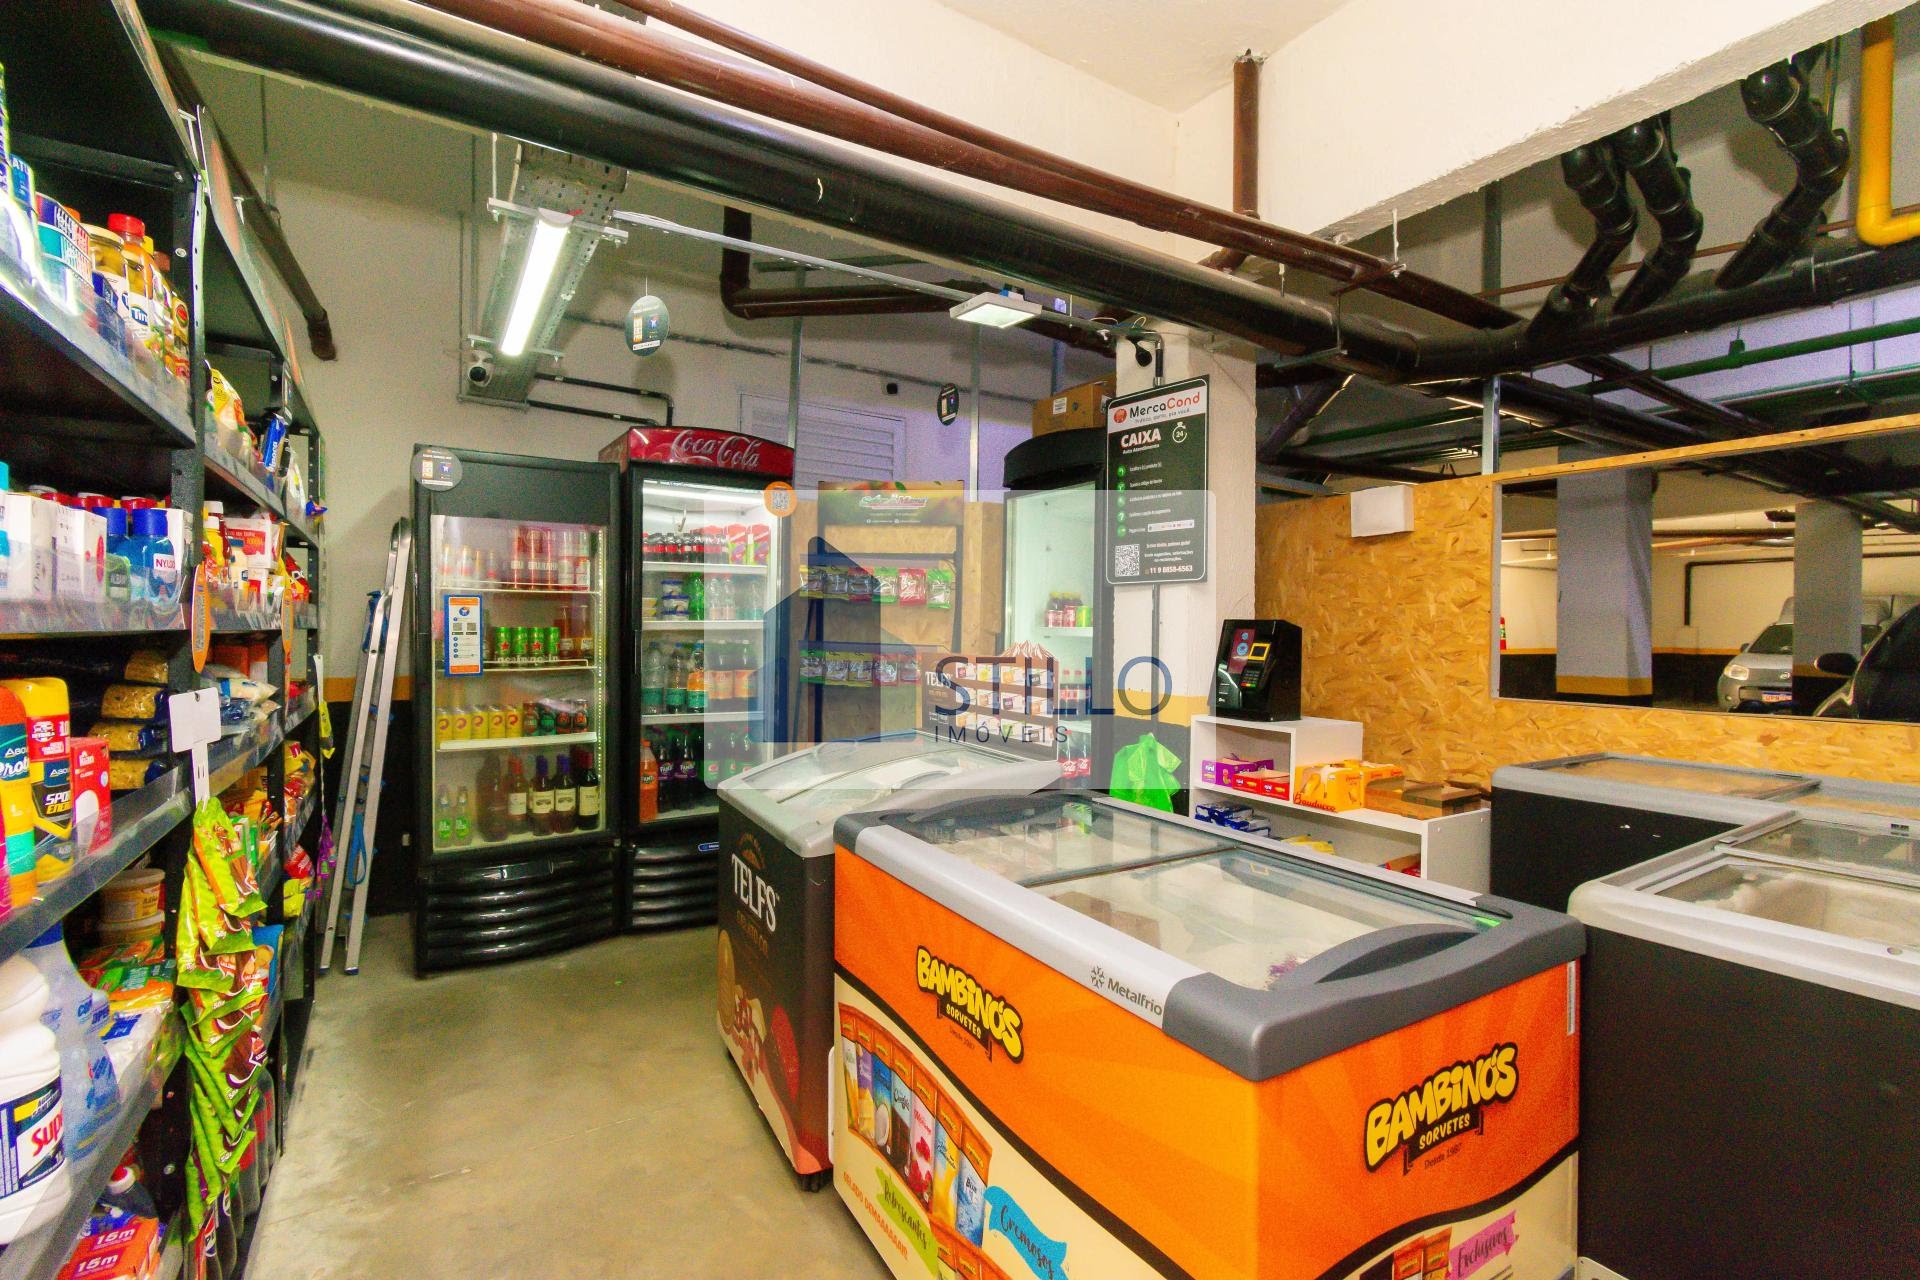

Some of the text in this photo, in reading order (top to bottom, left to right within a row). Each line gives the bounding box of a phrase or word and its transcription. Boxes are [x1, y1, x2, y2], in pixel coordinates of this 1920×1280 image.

[1129, 391, 1200, 419] MercaCond
[671, 429, 762, 467] Coca-Cola
[1121, 428, 1161, 448] CAIXA
[731, 853, 776, 932] TELFS
[917, 948, 1022, 1058] BAMBINO'S
[1107, 978, 1162, 1016] Metalfrio
[946, 1003, 982, 1040] SORVETES
[1366, 1047, 1517, 1167] BAMBINO'S
[1419, 1113, 1471, 1149] SORVETES
[96, 1227, 136, 1246] 15m
[76, 1253, 119, 1273] 15m
